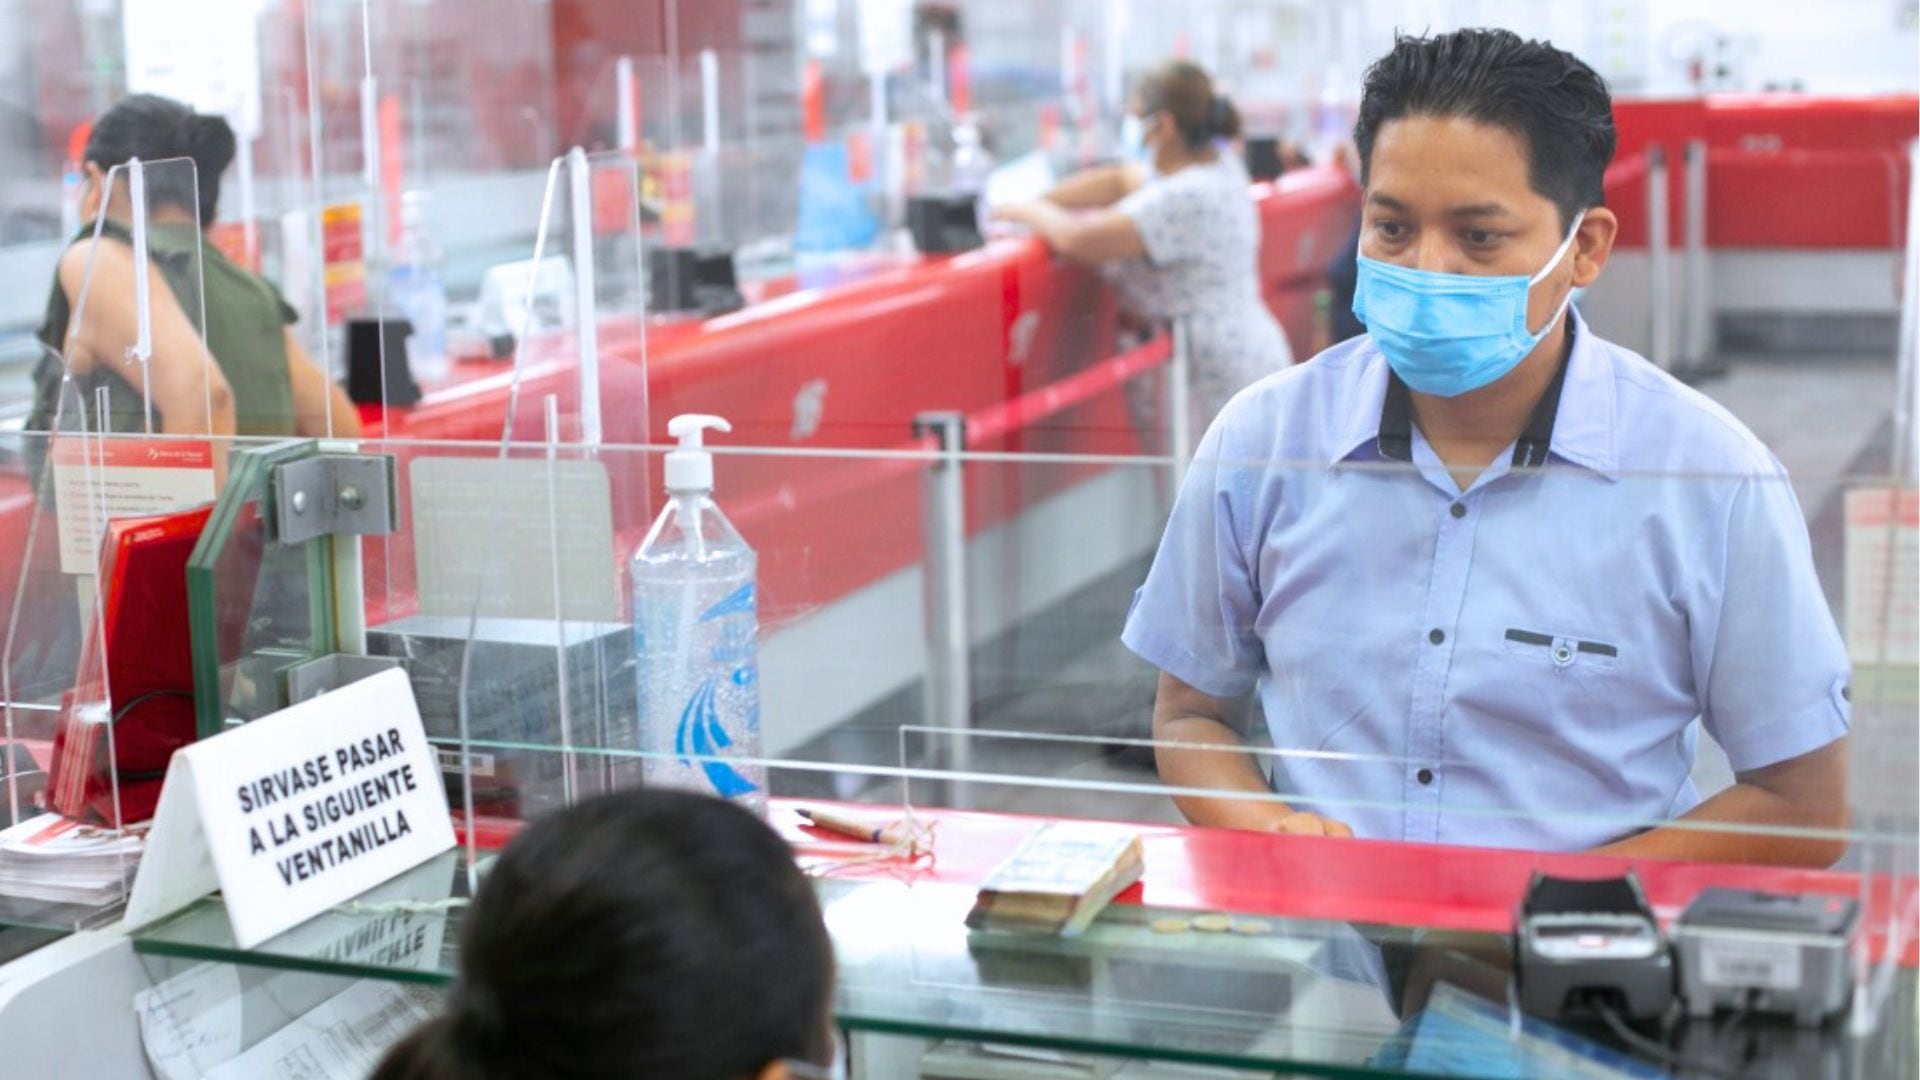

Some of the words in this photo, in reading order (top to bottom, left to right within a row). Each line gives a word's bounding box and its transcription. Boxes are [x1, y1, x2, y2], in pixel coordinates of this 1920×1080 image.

[238, 755, 333, 814] SIRVASE
[335, 728, 404, 776] PASAR
[250, 827, 266, 855] A
[268, 813, 300, 847] LA
[303, 764, 417, 832] SIGUIENTE
[277, 809, 411, 886] VENTANILLA
